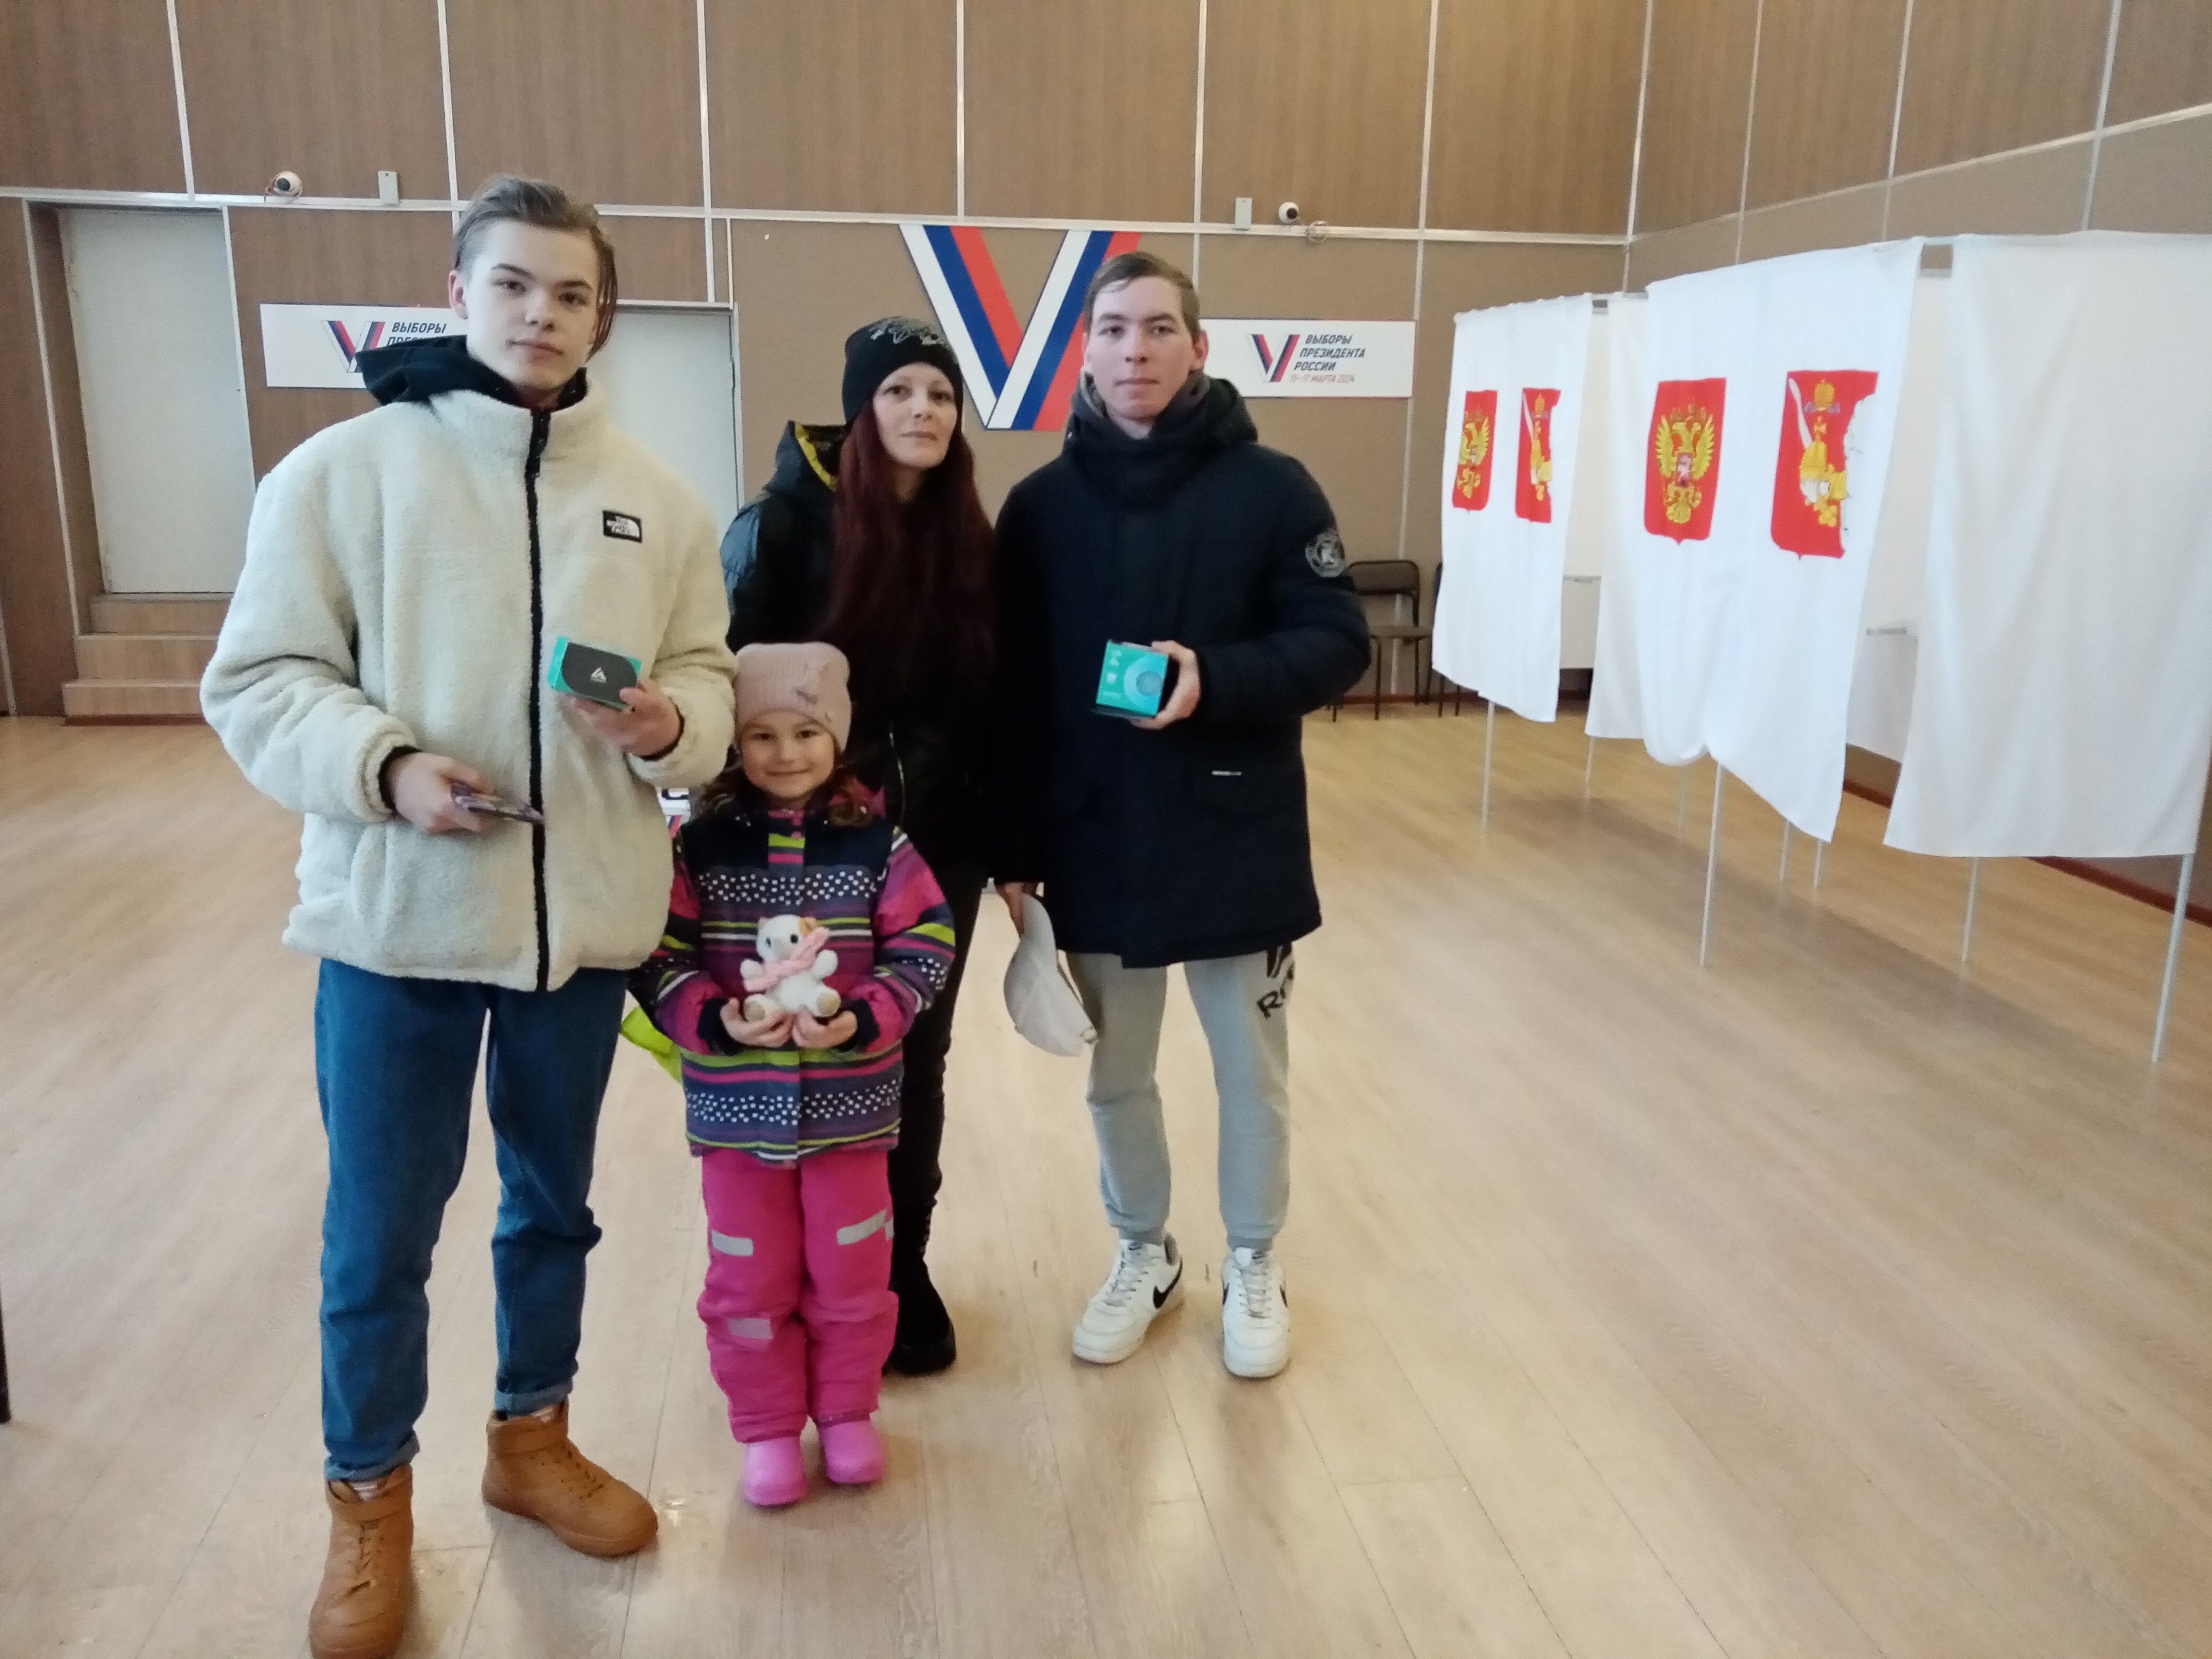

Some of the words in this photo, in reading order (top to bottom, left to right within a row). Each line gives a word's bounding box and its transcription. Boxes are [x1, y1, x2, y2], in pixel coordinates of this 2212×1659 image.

[391, 322, 447, 333] ВЫБОРЫ
[1305, 334, 1353, 344] ВЫБОРЫ
[1300, 348, 1366, 358] ПРЕЗИДЕНТА
[1294, 362, 1337, 371] РОССИИ
